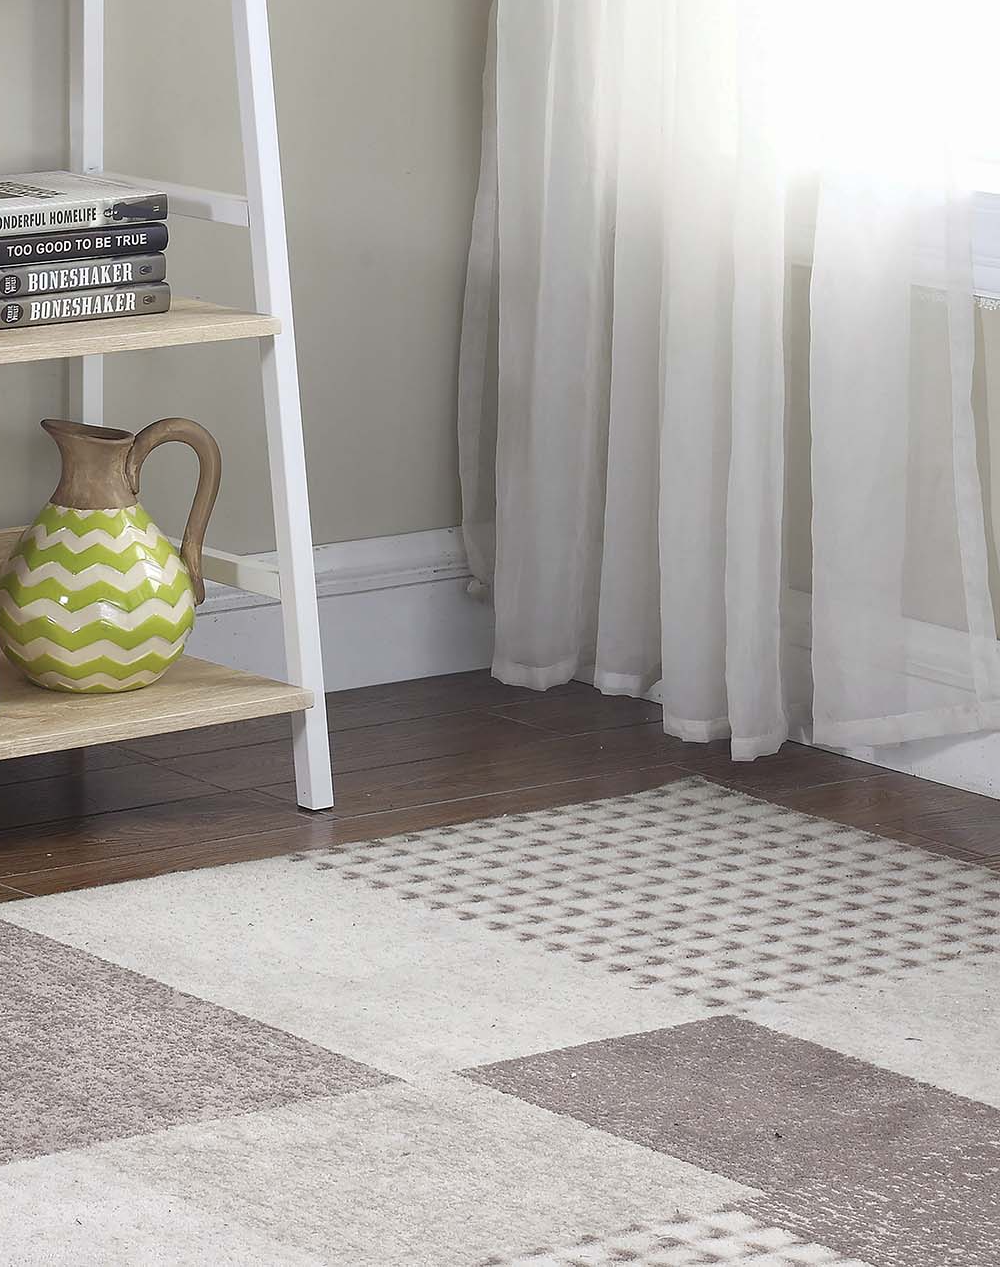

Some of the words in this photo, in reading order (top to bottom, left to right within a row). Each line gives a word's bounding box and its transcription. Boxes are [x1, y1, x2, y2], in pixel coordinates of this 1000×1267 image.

[49, 207, 98, 226] HOMELIFE
[6, 243, 32, 258] TOO
[36, 240, 72, 255] GOOD
[74, 238, 93, 252] TO
[95, 236, 112, 249] BE
[115, 233, 147, 247] TRUE
[27, 262, 133, 292] BONESHAKER
[29, 292, 136, 321] BONESHAKER
